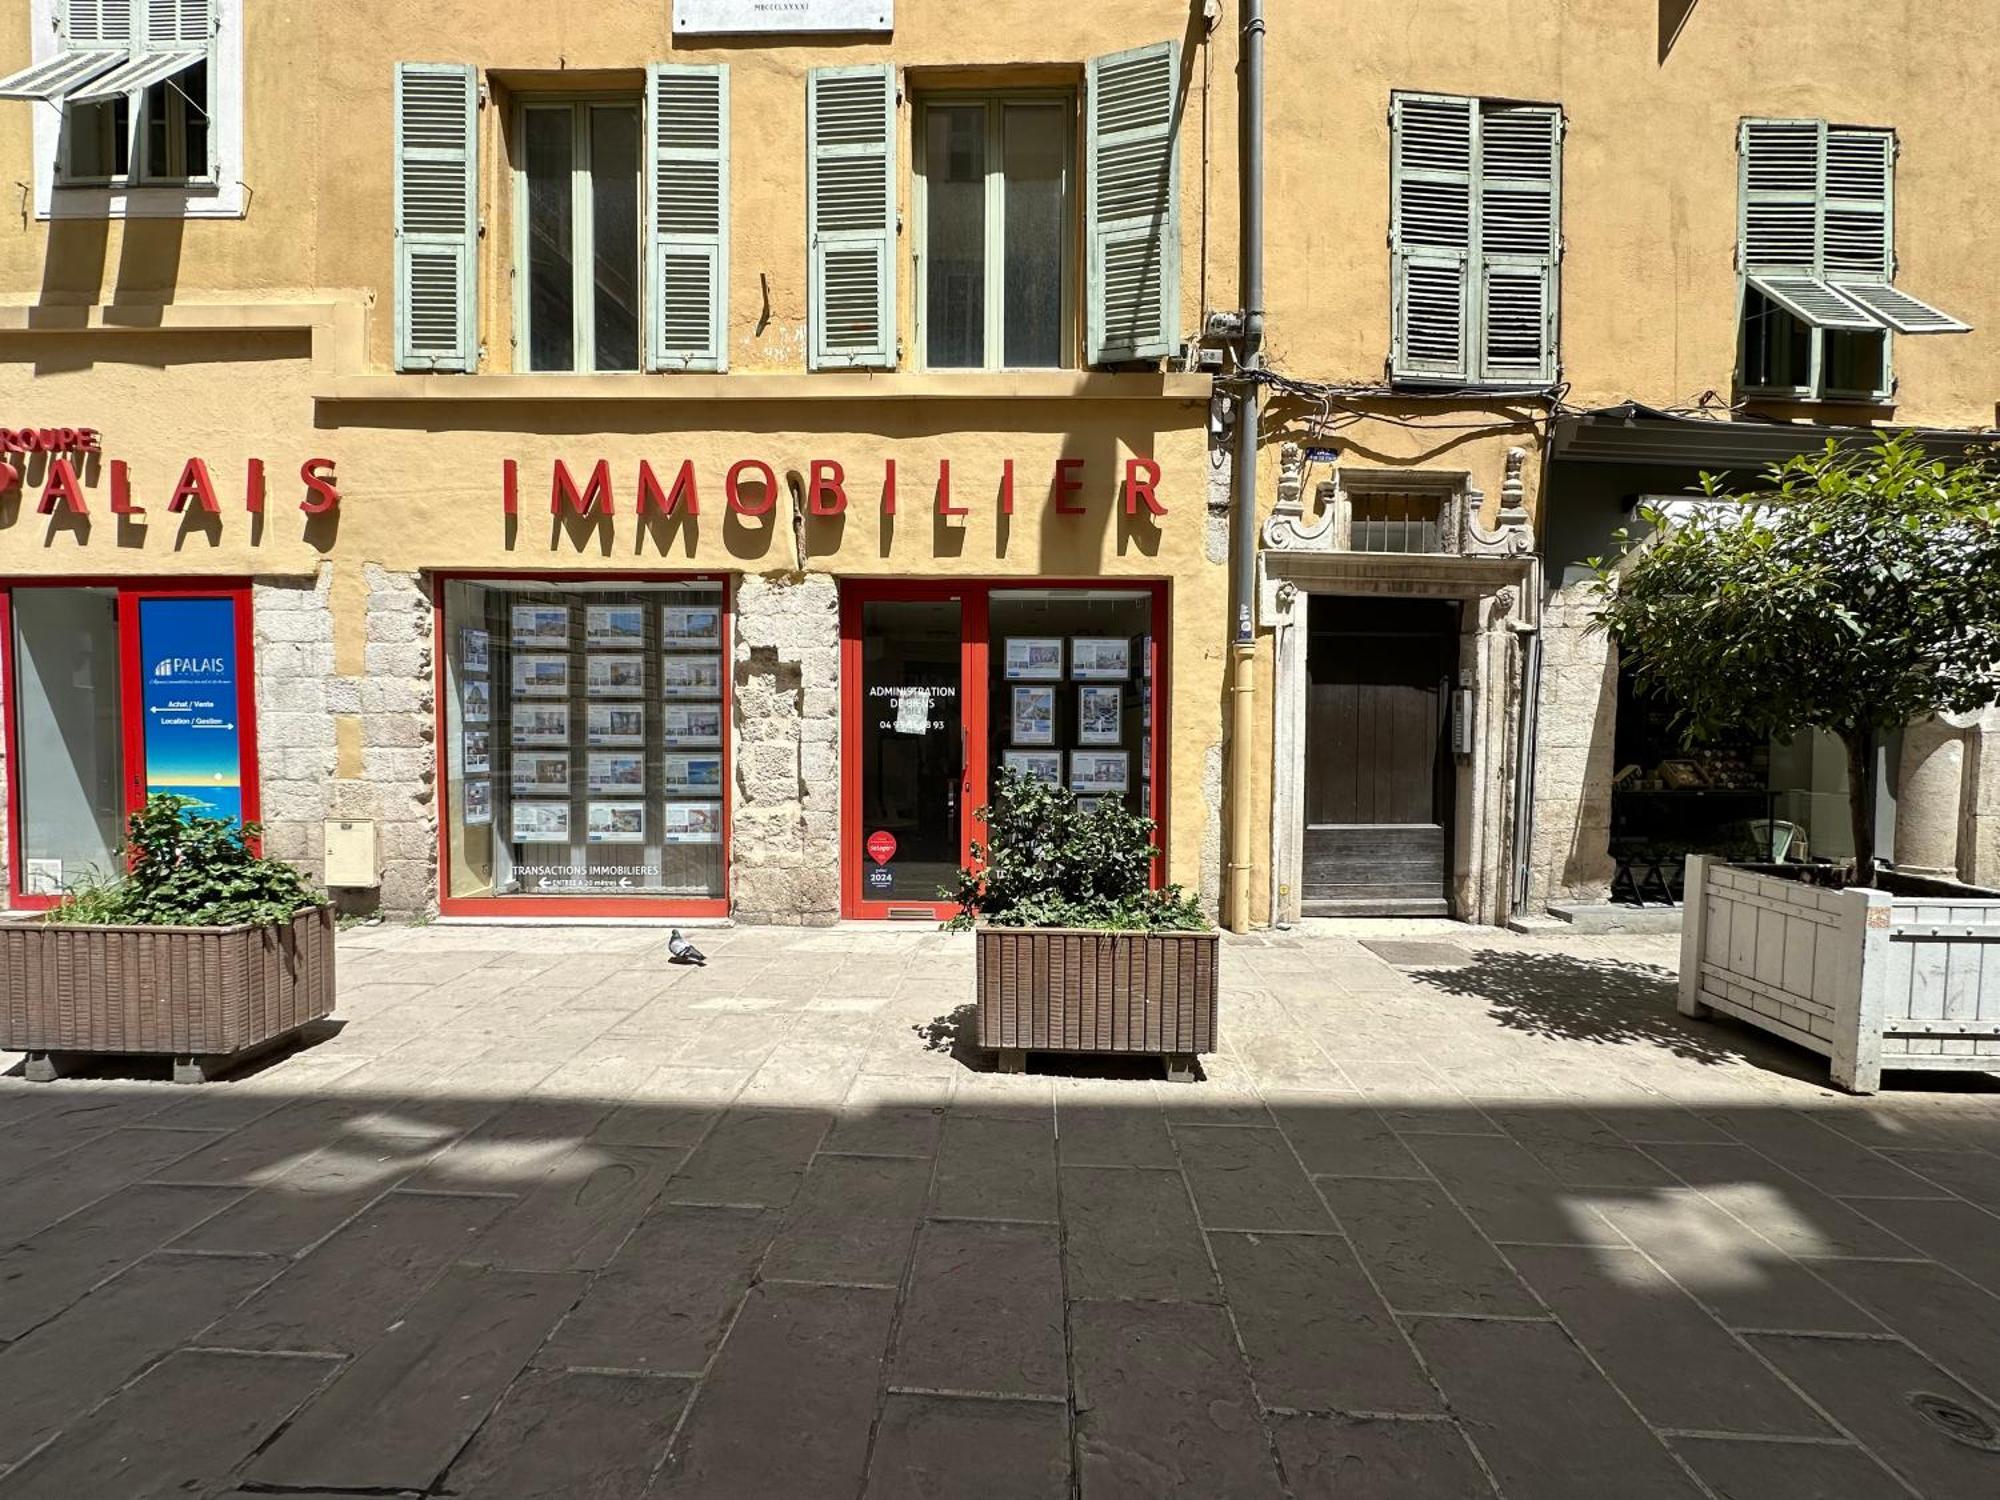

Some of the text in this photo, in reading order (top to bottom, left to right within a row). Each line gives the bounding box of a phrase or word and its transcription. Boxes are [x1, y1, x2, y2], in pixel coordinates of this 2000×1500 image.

[503, 459, 1168, 516] IMMOBILIER
[174, 658, 224, 672] PALAIS
[869, 686, 956, 697] ADMINISTRATION
[512, 866, 659, 876] TRANSACTIONS IMMOBILIERES
[870, 873, 893, 881] 2024
